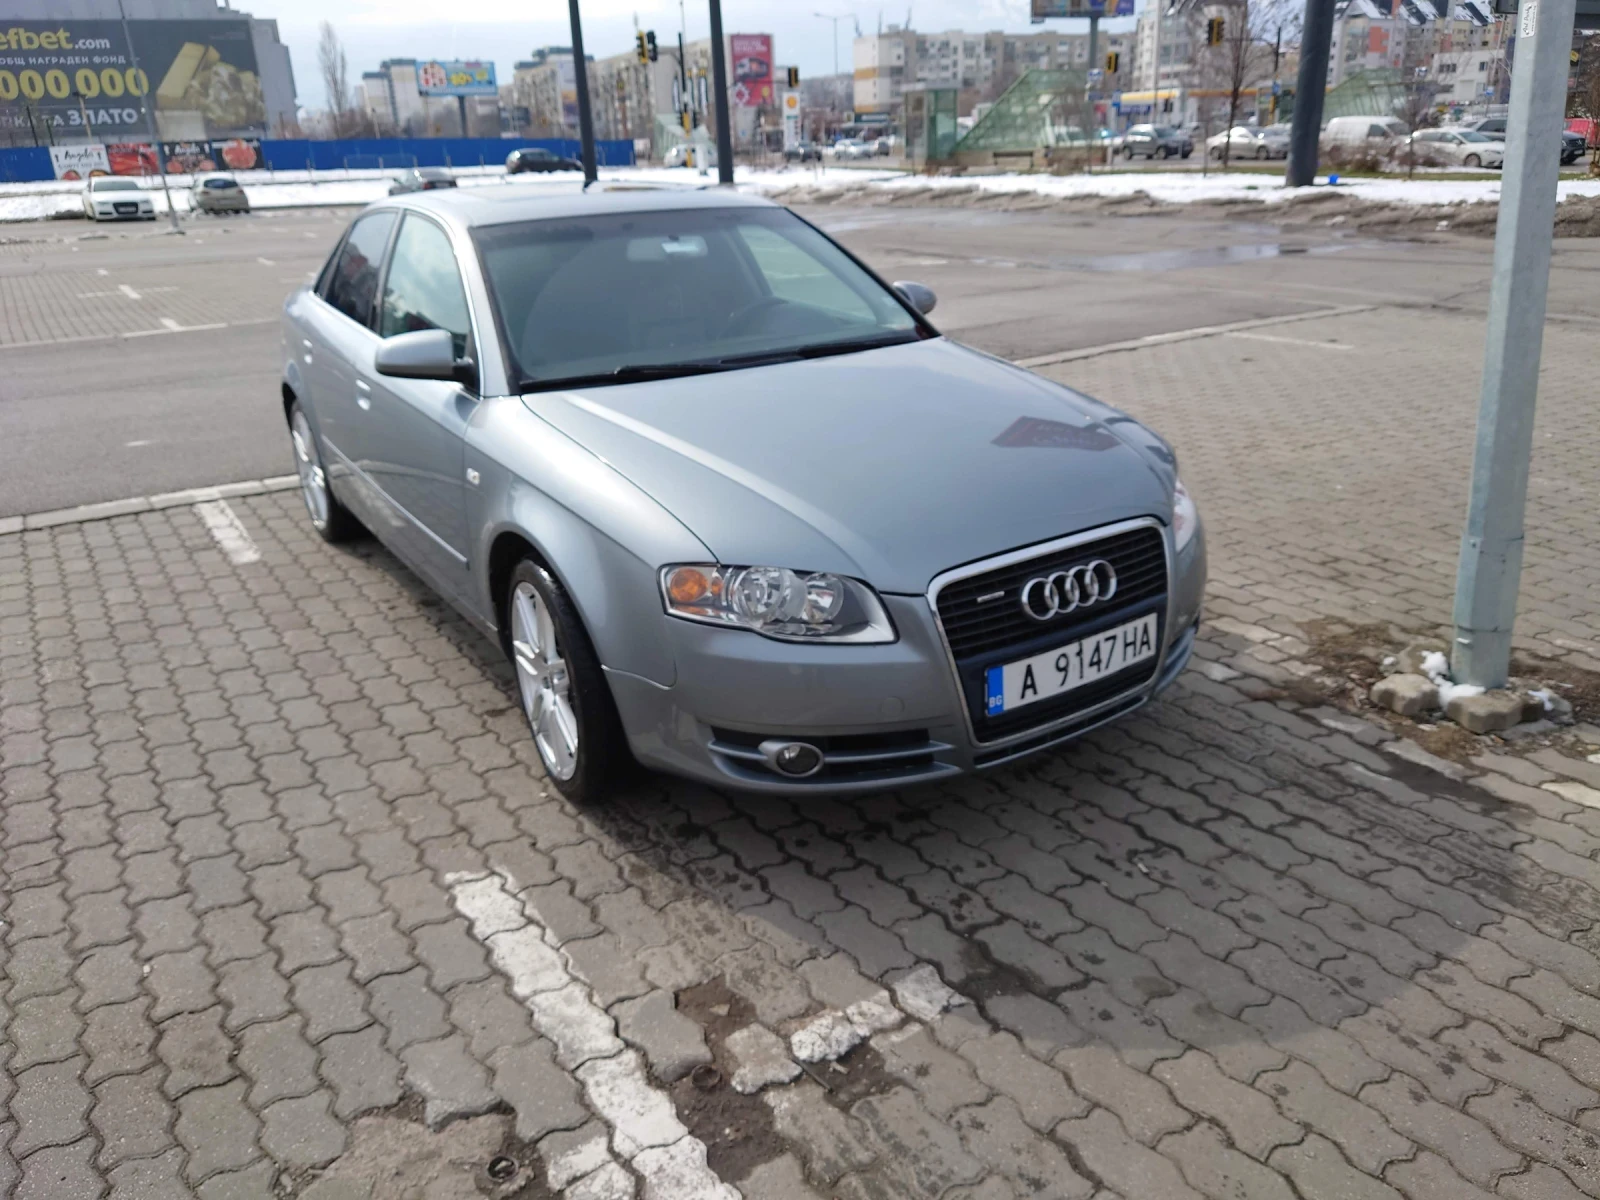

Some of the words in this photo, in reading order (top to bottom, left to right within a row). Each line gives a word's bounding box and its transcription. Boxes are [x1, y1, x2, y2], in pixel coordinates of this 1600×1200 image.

[29, 56, 89, 65] НАГРАДЕН
[92, 55, 127, 65] ФОНД
[67, 108, 138, 125] ЗЛАТО
[1020, 664, 1038, 700] A
[1055, 635, 1117, 687] 9147
[1123, 622, 1151, 661] HA
[989, 695, 1003, 708] BG
